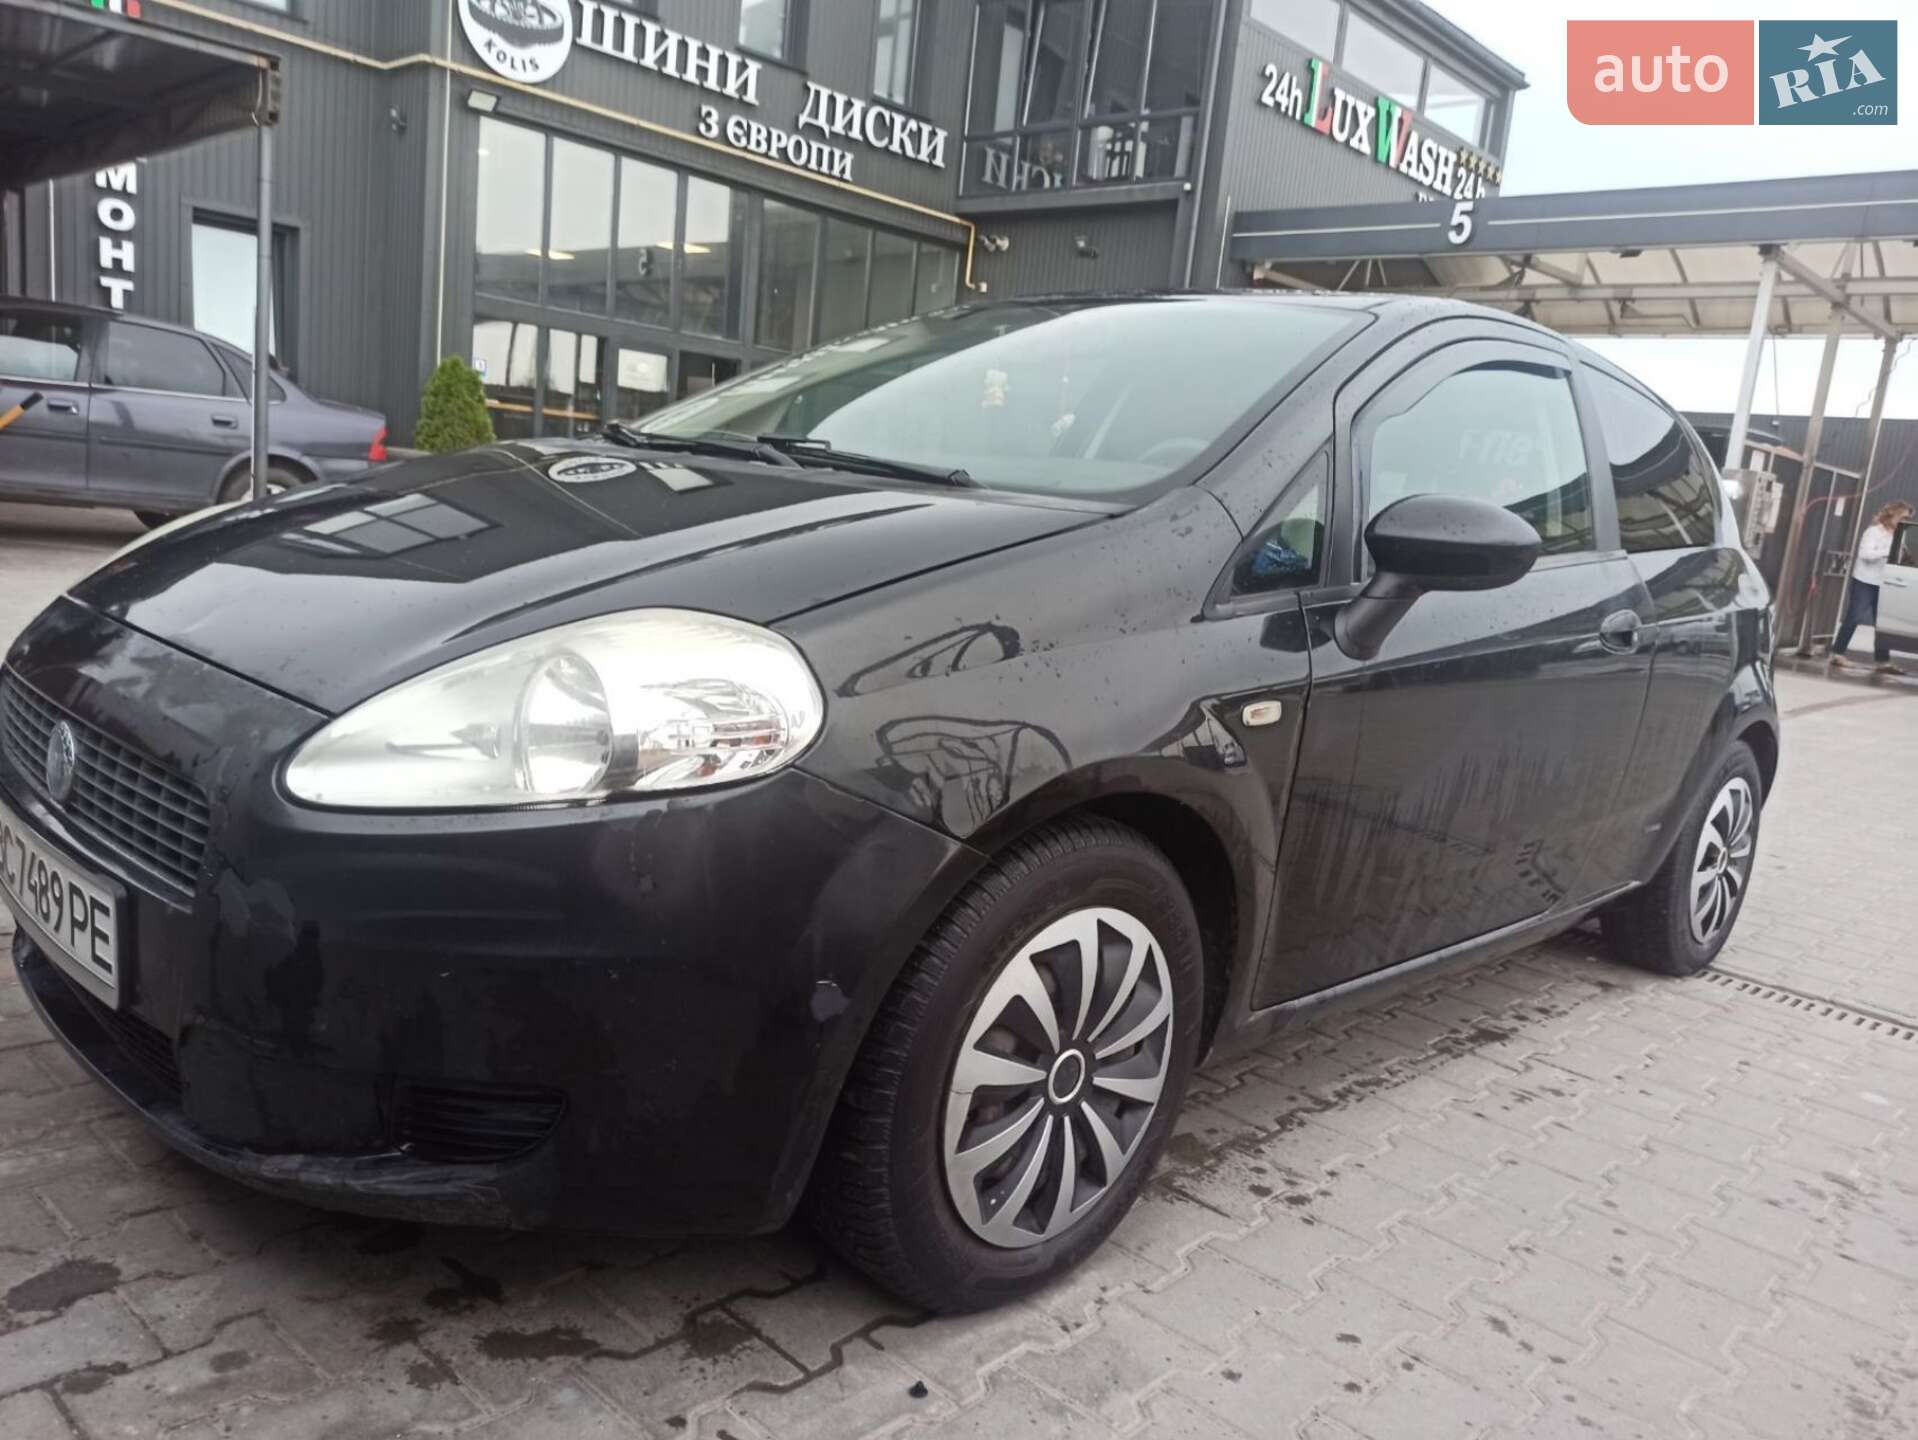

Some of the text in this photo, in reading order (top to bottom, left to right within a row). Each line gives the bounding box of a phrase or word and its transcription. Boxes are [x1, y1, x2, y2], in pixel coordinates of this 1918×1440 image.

[576, 0, 762, 106] ШИНИ
[798, 81, 948, 169] ДИСКИ
[1261, 63, 1302, 121] 24h
[726, 114, 855, 181] ЄВРОПИ
[1448, 201, 1474, 245] 5
